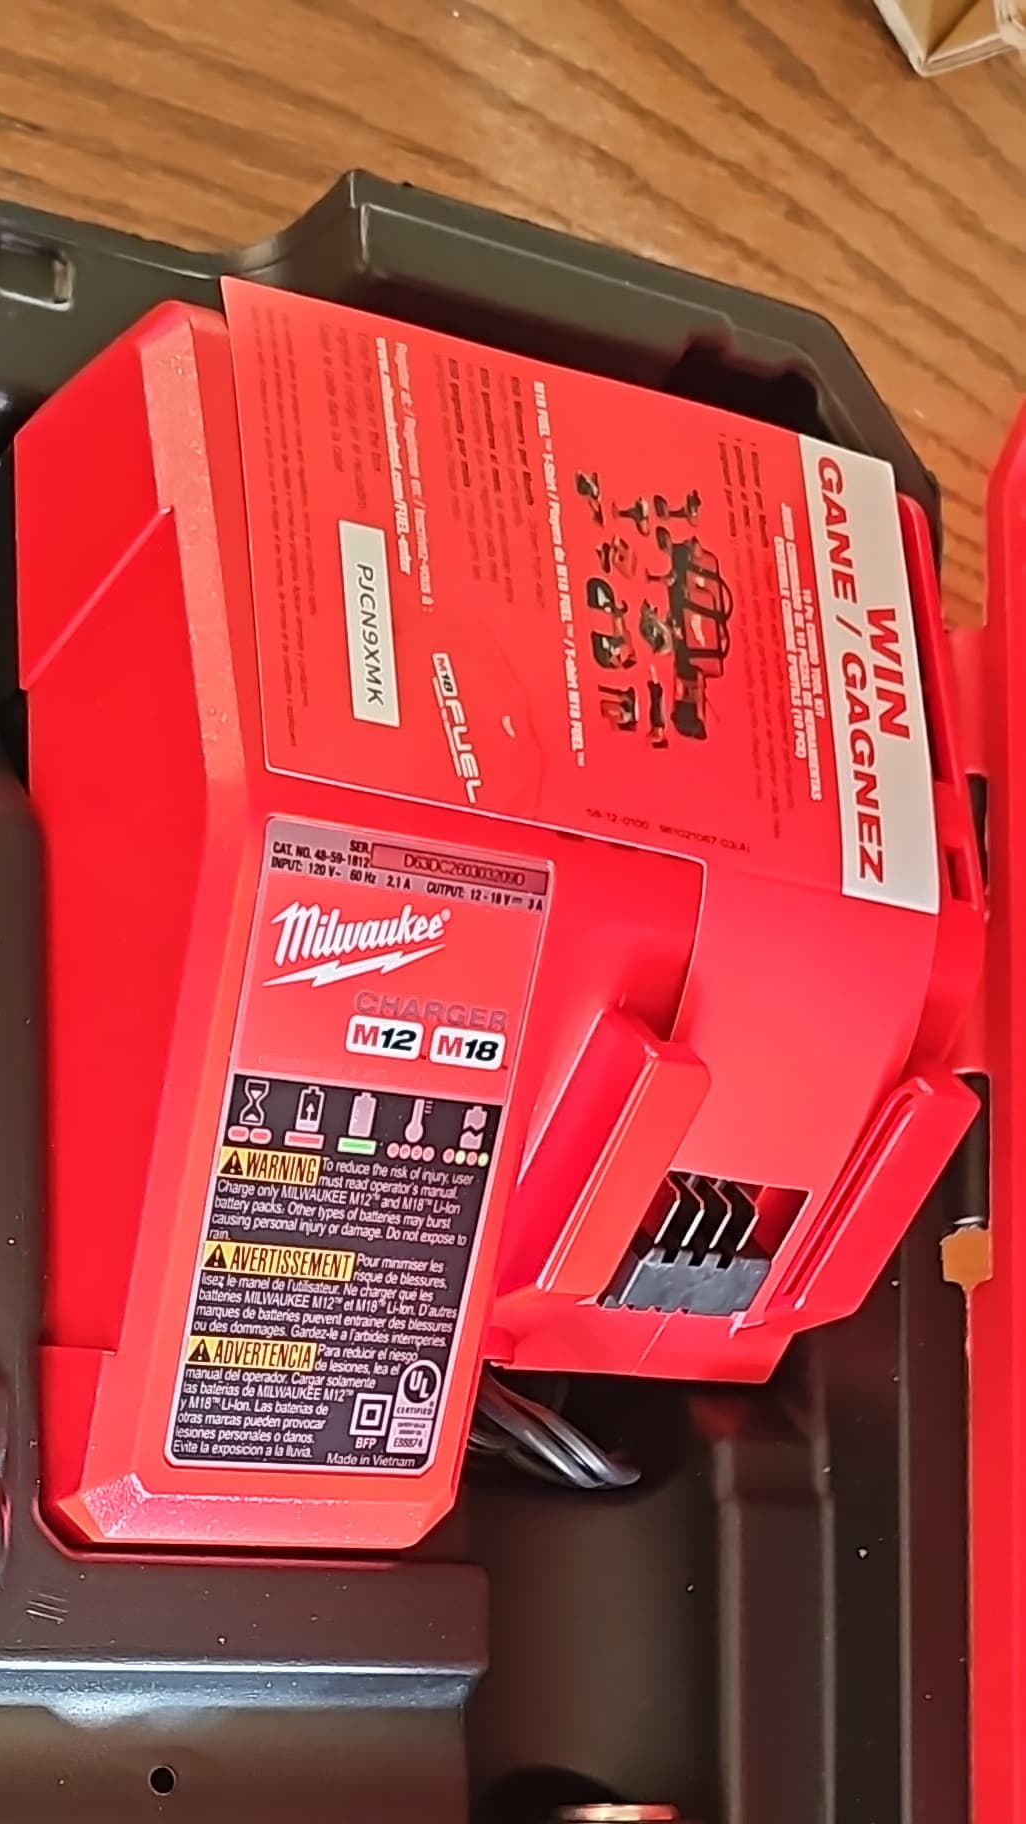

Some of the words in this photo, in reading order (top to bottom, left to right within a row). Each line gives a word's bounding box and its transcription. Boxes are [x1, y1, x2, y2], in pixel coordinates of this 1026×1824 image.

[818, 456, 857, 604] GANE
[357, 563, 384, 705] PJCN9XMK
[835, 613, 863, 638] /
[866, 608, 911, 740] WIN
[436, 657, 453, 693] M18
[445, 699, 482, 804] FUEL
[841, 651, 884, 884] GAGNEZ
[272, 842, 293, 855] CAT.
[313, 849, 370, 868] 48-59-1812
[270, 856, 303, 871] INPUT:
[308, 862, 326, 875] 120
[348, 869, 362, 881] 60
[363, 872, 376, 883] Hz
[426, 881, 465, 898] OUTPUT:
[356, 991, 508, 1031] CHARGER
[352, 1023, 417, 1051] M12
[436, 1034, 499, 1062] M18
[244, 1151, 317, 1183] WARNING
[321, 1157, 334, 1171] To
[335, 1159, 370, 1175] reduce
[371, 1163, 388, 1176] the
[390, 1164, 409, 1179] risk
[409, 1166, 421, 1180] of
[451, 1172, 474, 1185] user
[216, 1178, 256, 1198] Charge
[256, 1182, 280, 1199] only
[280, 1184, 347, 1204] MILWAUKEE
[380, 1195, 400, 1209] and
[317, 1173, 343, 1188] must
[344, 1176, 368, 1190] read
[369, 1178, 419, 1198] operator's
[213, 1194, 250, 1213] battery
[286, 1201, 317, 1217] Other
[316, 1205, 345, 1222] types
[346, 1207, 358, 1220] of
[358, 1209, 401, 1224] batteries
[402, 1215, 425, 1229] may
[425, 1215, 451, 1229] burst
[210, 1212, 251, 1230] causing
[252, 1214, 298, 1233] personal
[299, 1220, 327, 1237] injury
[327, 1224, 339, 1235] or
[385, 1226, 401, 1240] Do
[402, 1228, 419, 1241] not
[419, 1231, 456, 1247] expose
[456, 1233, 467, 1246] to
[229, 1244, 352, 1279] AVERTISSEMENT
[356, 1253, 379, 1267] Pour
[380, 1255, 429, 1271] minimiser
[428, 1259, 445, 1273] les
[200, 1271, 225, 1287] lisez
[271, 1277, 286, 1290] de
[342, 1282, 359, 1296] Ne
[358, 1285, 397, 1302] charger
[418, 1289, 434, 1302] les
[352, 1269, 383, 1286] risque
[384, 1270, 399, 1284] de
[198, 1287, 243, 1303] batteries
[243, 1289, 310, 1308] MILWAUKEE
[342, 1298, 354, 1311] et
[417, 1303, 458, 1319] D'autres
[193, 1320, 207, 1331] ou
[208, 1319, 228, 1332] des
[289, 1323, 339, 1340] Gardez-le
[195, 1304, 240, 1321] marques
[241, 1306, 256, 1319] de
[257, 1307, 301, 1323] batteries
[387, 1317, 406, 1330] des
[407, 1318, 453, 1334] blessures
[212, 1338, 313, 1369] ADVERTENCIA
[316, 1343, 342, 1357] Para
[342, 1345, 377, 1359] reducir
[376, 1347, 388, 1360] el
[387, 1350, 418, 1365] riesgo
[314, 1358, 327, 1371] de
[372, 1362, 389, 1375] lea
[389, 1363, 401, 1375] el
[182, 1381, 198, 1393] las
[241, 1384, 256, 1397] de
[256, 1384, 322, 1401] MILWAUKEE
[184, 1365, 223, 1380] manual
[224, 1368, 241, 1381] del
[290, 1371, 325, 1388] Cargar
[325, 1374, 377, 1389] solamente
[406, 1369, 434, 1398] UL
[177, 1411, 203, 1424] otras
[204, 1413, 242, 1425] marcas
[243, 1415, 281, 1430] pueden
[281, 1417, 326, 1432] provocar
[179, 1398, 187, 1410] y
[253, 1400, 273, 1412] Las
[315, 1403, 329, 1415] de
[395, 1406, 433, 1416] CERTIFIED
[172, 1439, 198, 1453] Evite
[199, 1441, 210, 1453] la
[273, 1444, 284, 1456] la
[174, 1425, 217, 1439] lesiones
[217, 1427, 272, 1444] personales
[354, 1437, 377, 1449] BFP
[326, 1452, 358, 1465] Made
[359, 1454, 370, 1465] in
[371, 1455, 416, 1467] Vietnam
